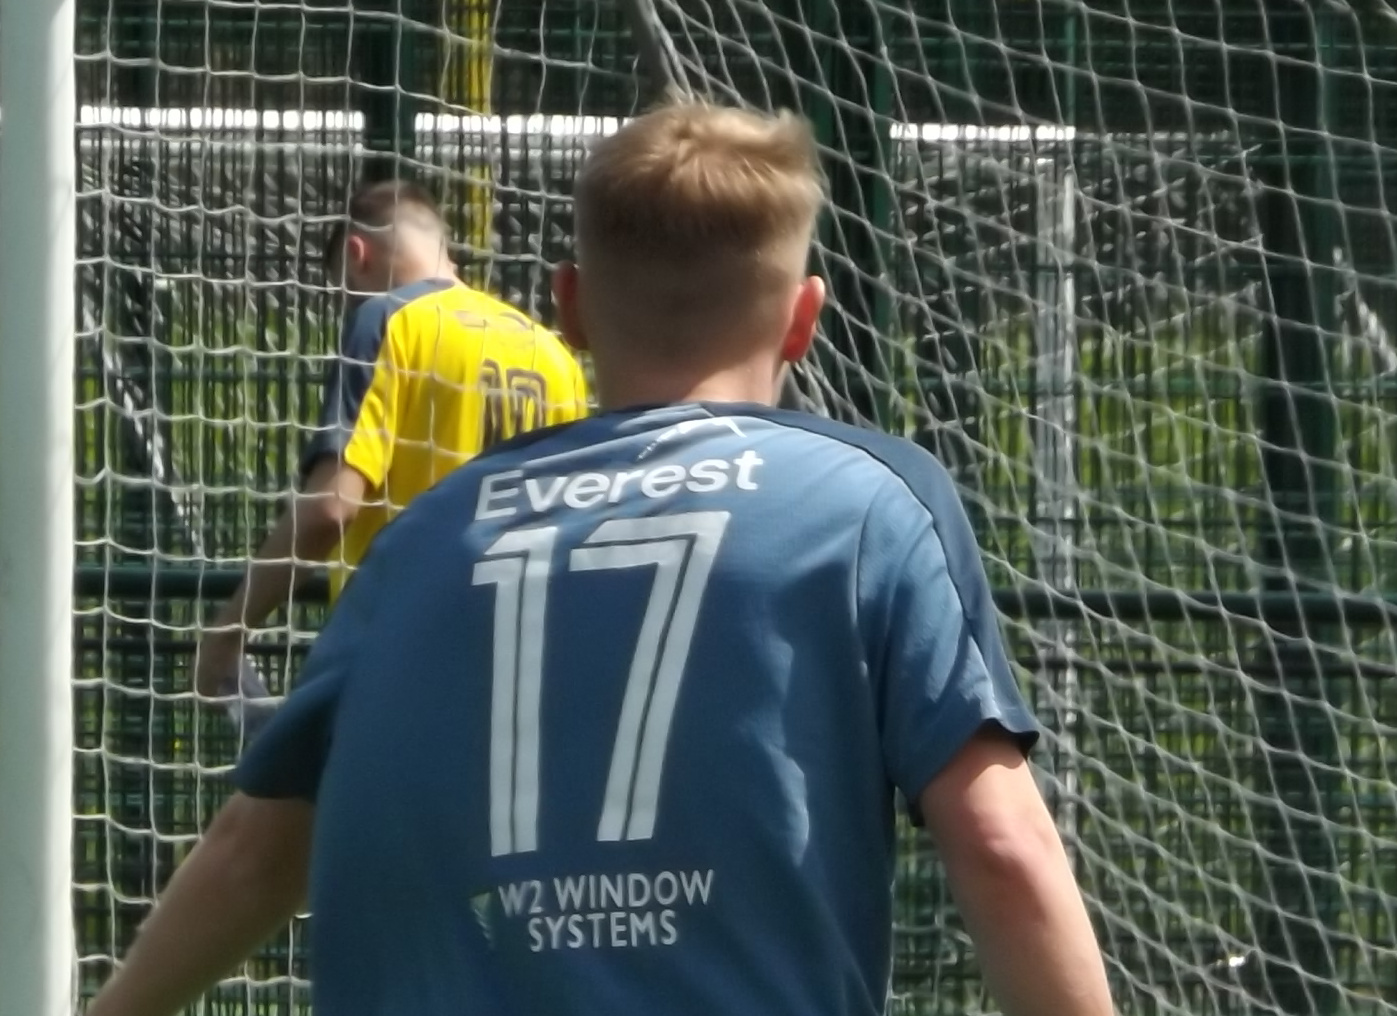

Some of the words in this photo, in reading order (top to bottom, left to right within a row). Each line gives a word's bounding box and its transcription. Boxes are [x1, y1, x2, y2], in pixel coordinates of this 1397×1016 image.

[475, 450, 763, 520] Everest
[471, 511, 731, 857] 17
[498, 879, 544, 918] W2
[554, 869, 714, 911] WINDOW
[528, 909, 678, 952] SYSTEMS
